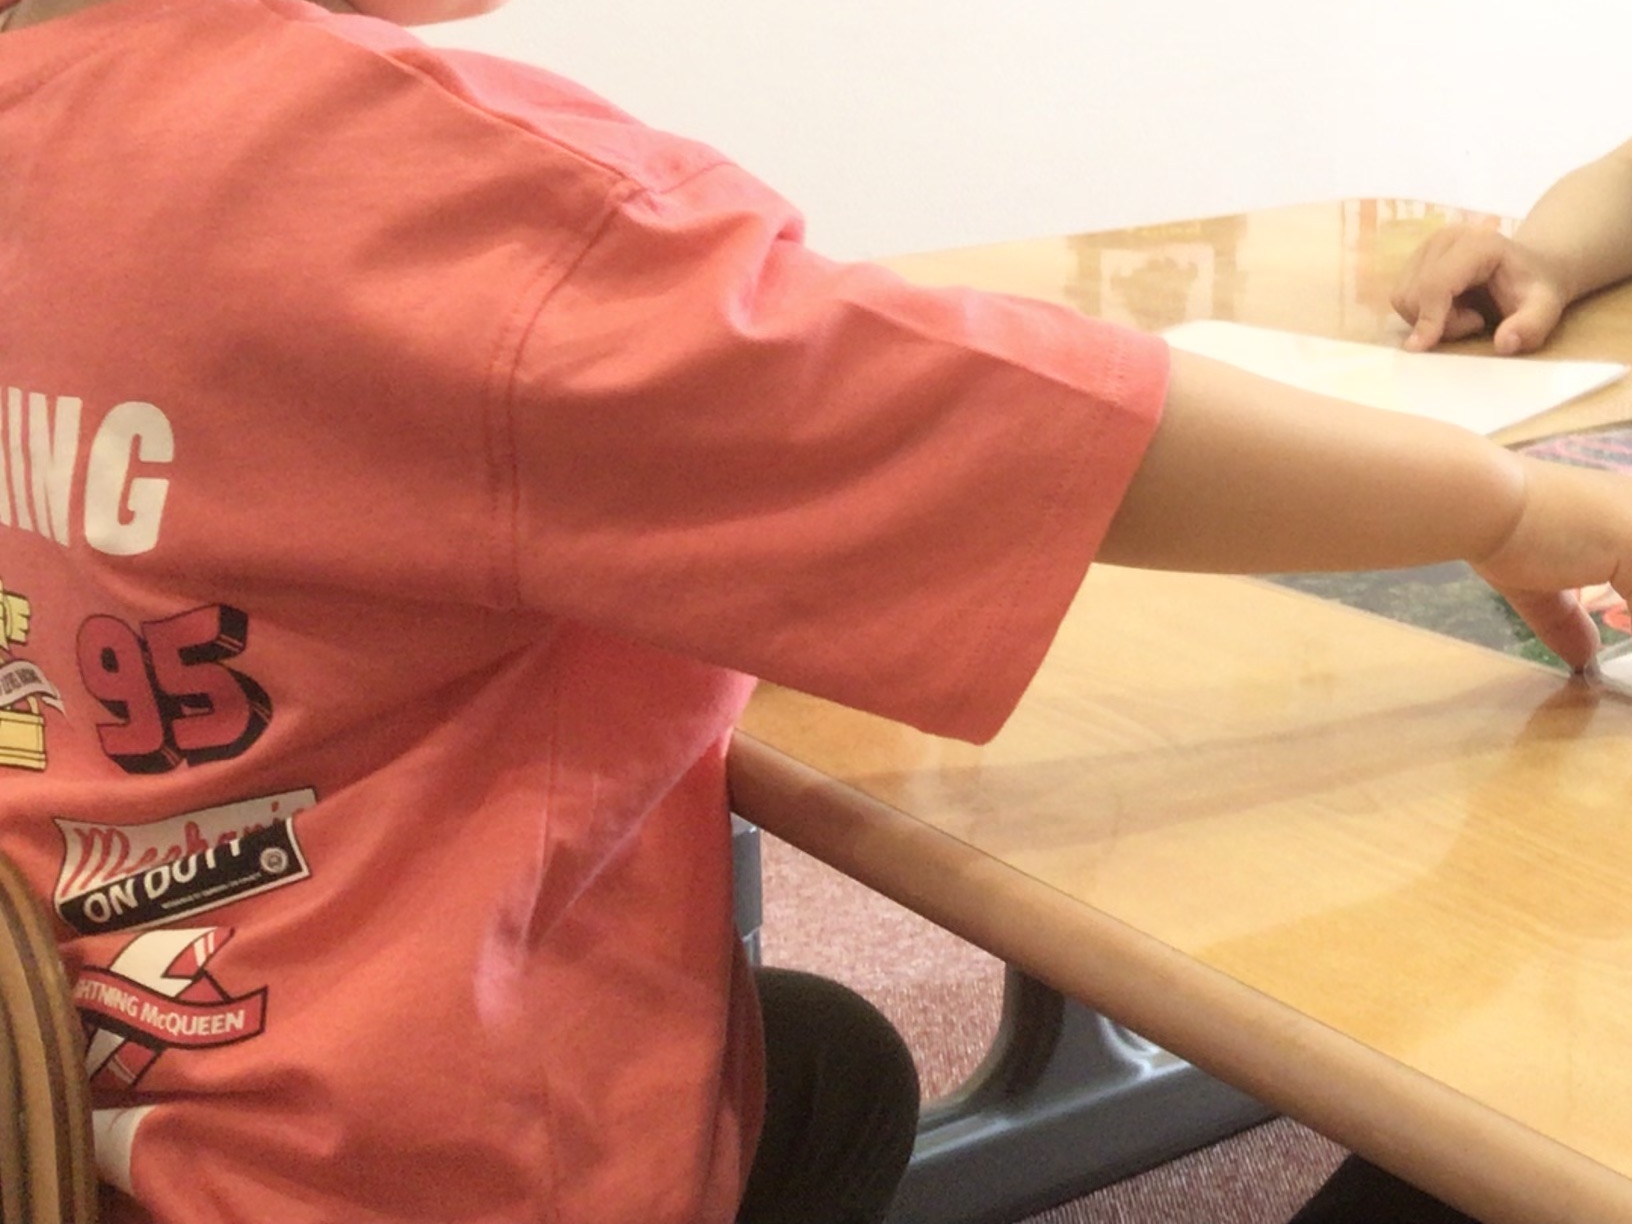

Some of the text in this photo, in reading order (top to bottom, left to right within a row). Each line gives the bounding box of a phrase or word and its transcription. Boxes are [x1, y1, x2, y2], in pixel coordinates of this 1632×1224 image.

[0, 386, 175, 556] ING
[76, 603, 273, 774] 95
[84, 877, 139, 923] ON
[143, 838, 242, 899] DUTY
[140, 1001, 246, 1037] McQUEEN
